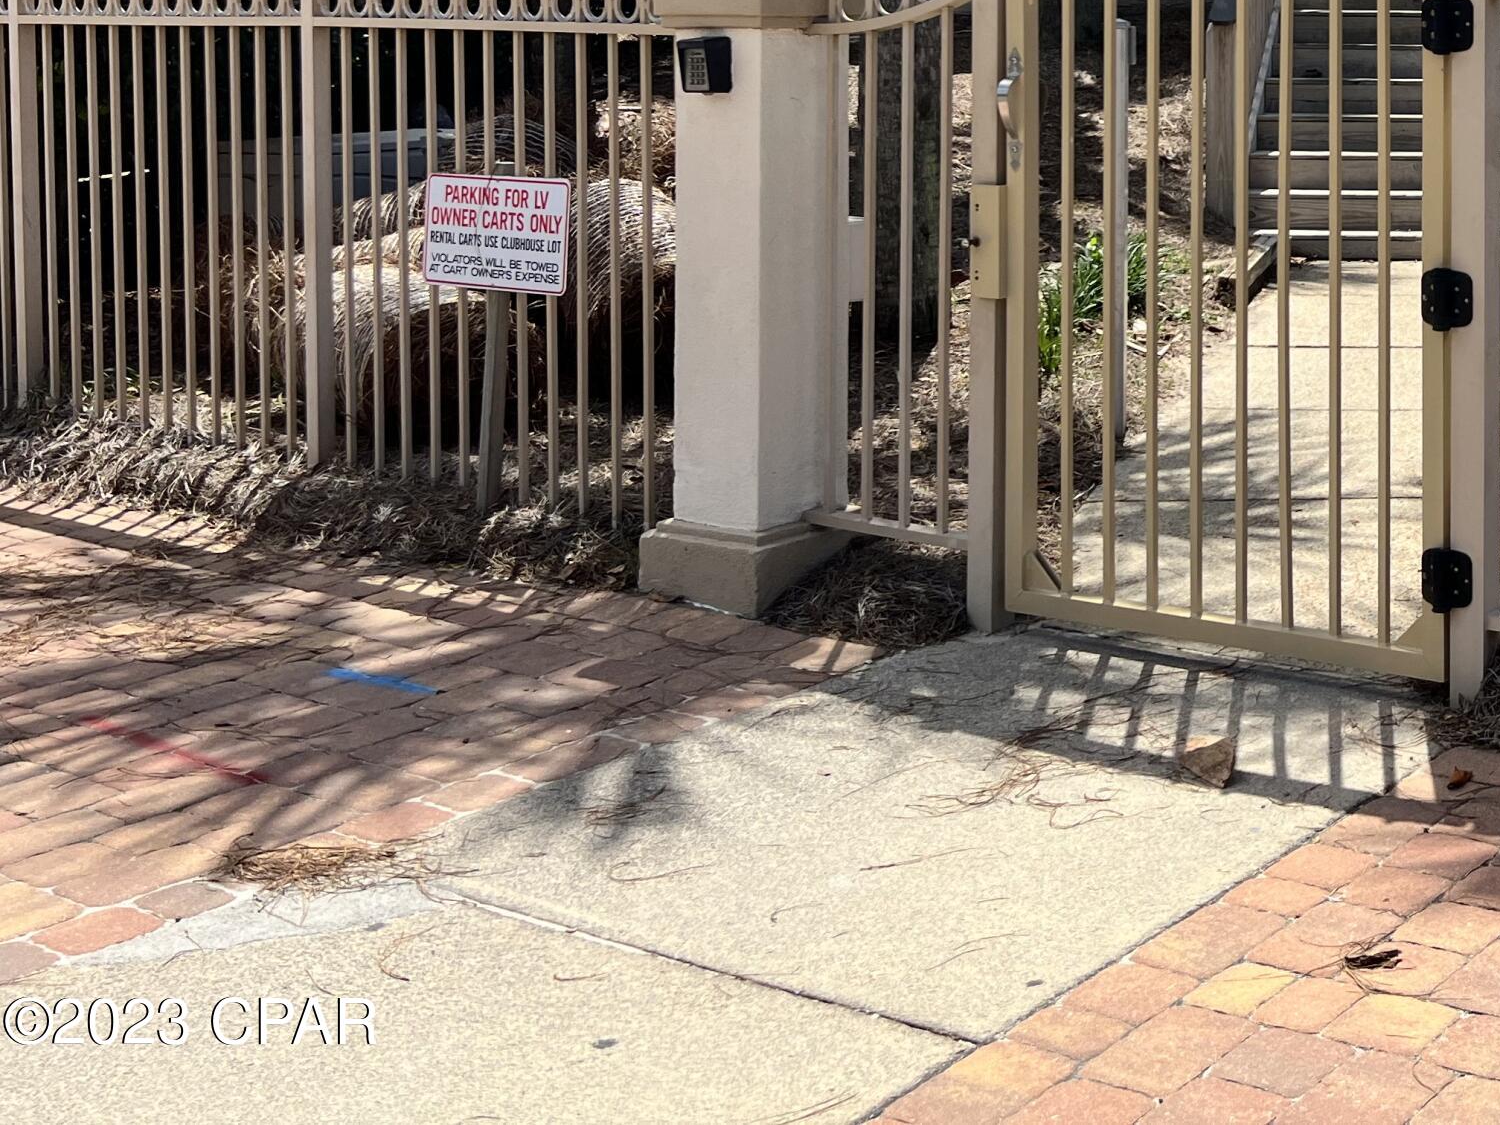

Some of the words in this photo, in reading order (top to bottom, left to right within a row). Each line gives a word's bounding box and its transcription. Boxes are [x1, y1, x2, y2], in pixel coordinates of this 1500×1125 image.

[445, 184, 500, 207] PARKING
[504, 188, 529, 209] FOR
[534, 190, 549, 210] LV
[431, 206, 477, 228] OWNER
[482, 210, 525, 232] CARTS
[530, 213, 563, 235] ONLY
[430, 230, 456, 245] RENTAL
[458, 232, 482, 247] CARTS
[484, 235, 499, 248] USE
[501, 237, 545, 252] CLUBHOUSE
[547, 239, 561, 254] LOT
[429, 263, 441, 273] AT
[443, 264, 468, 276] CART
[471, 267, 513, 281] OWNER'S
[515, 272, 560, 285] EXPENSE
[431, 252, 483, 266] VIOLATORS
[485, 257, 507, 269] WILL
[509, 260, 522, 270] BE
[525, 261, 559, 273] TOWED
